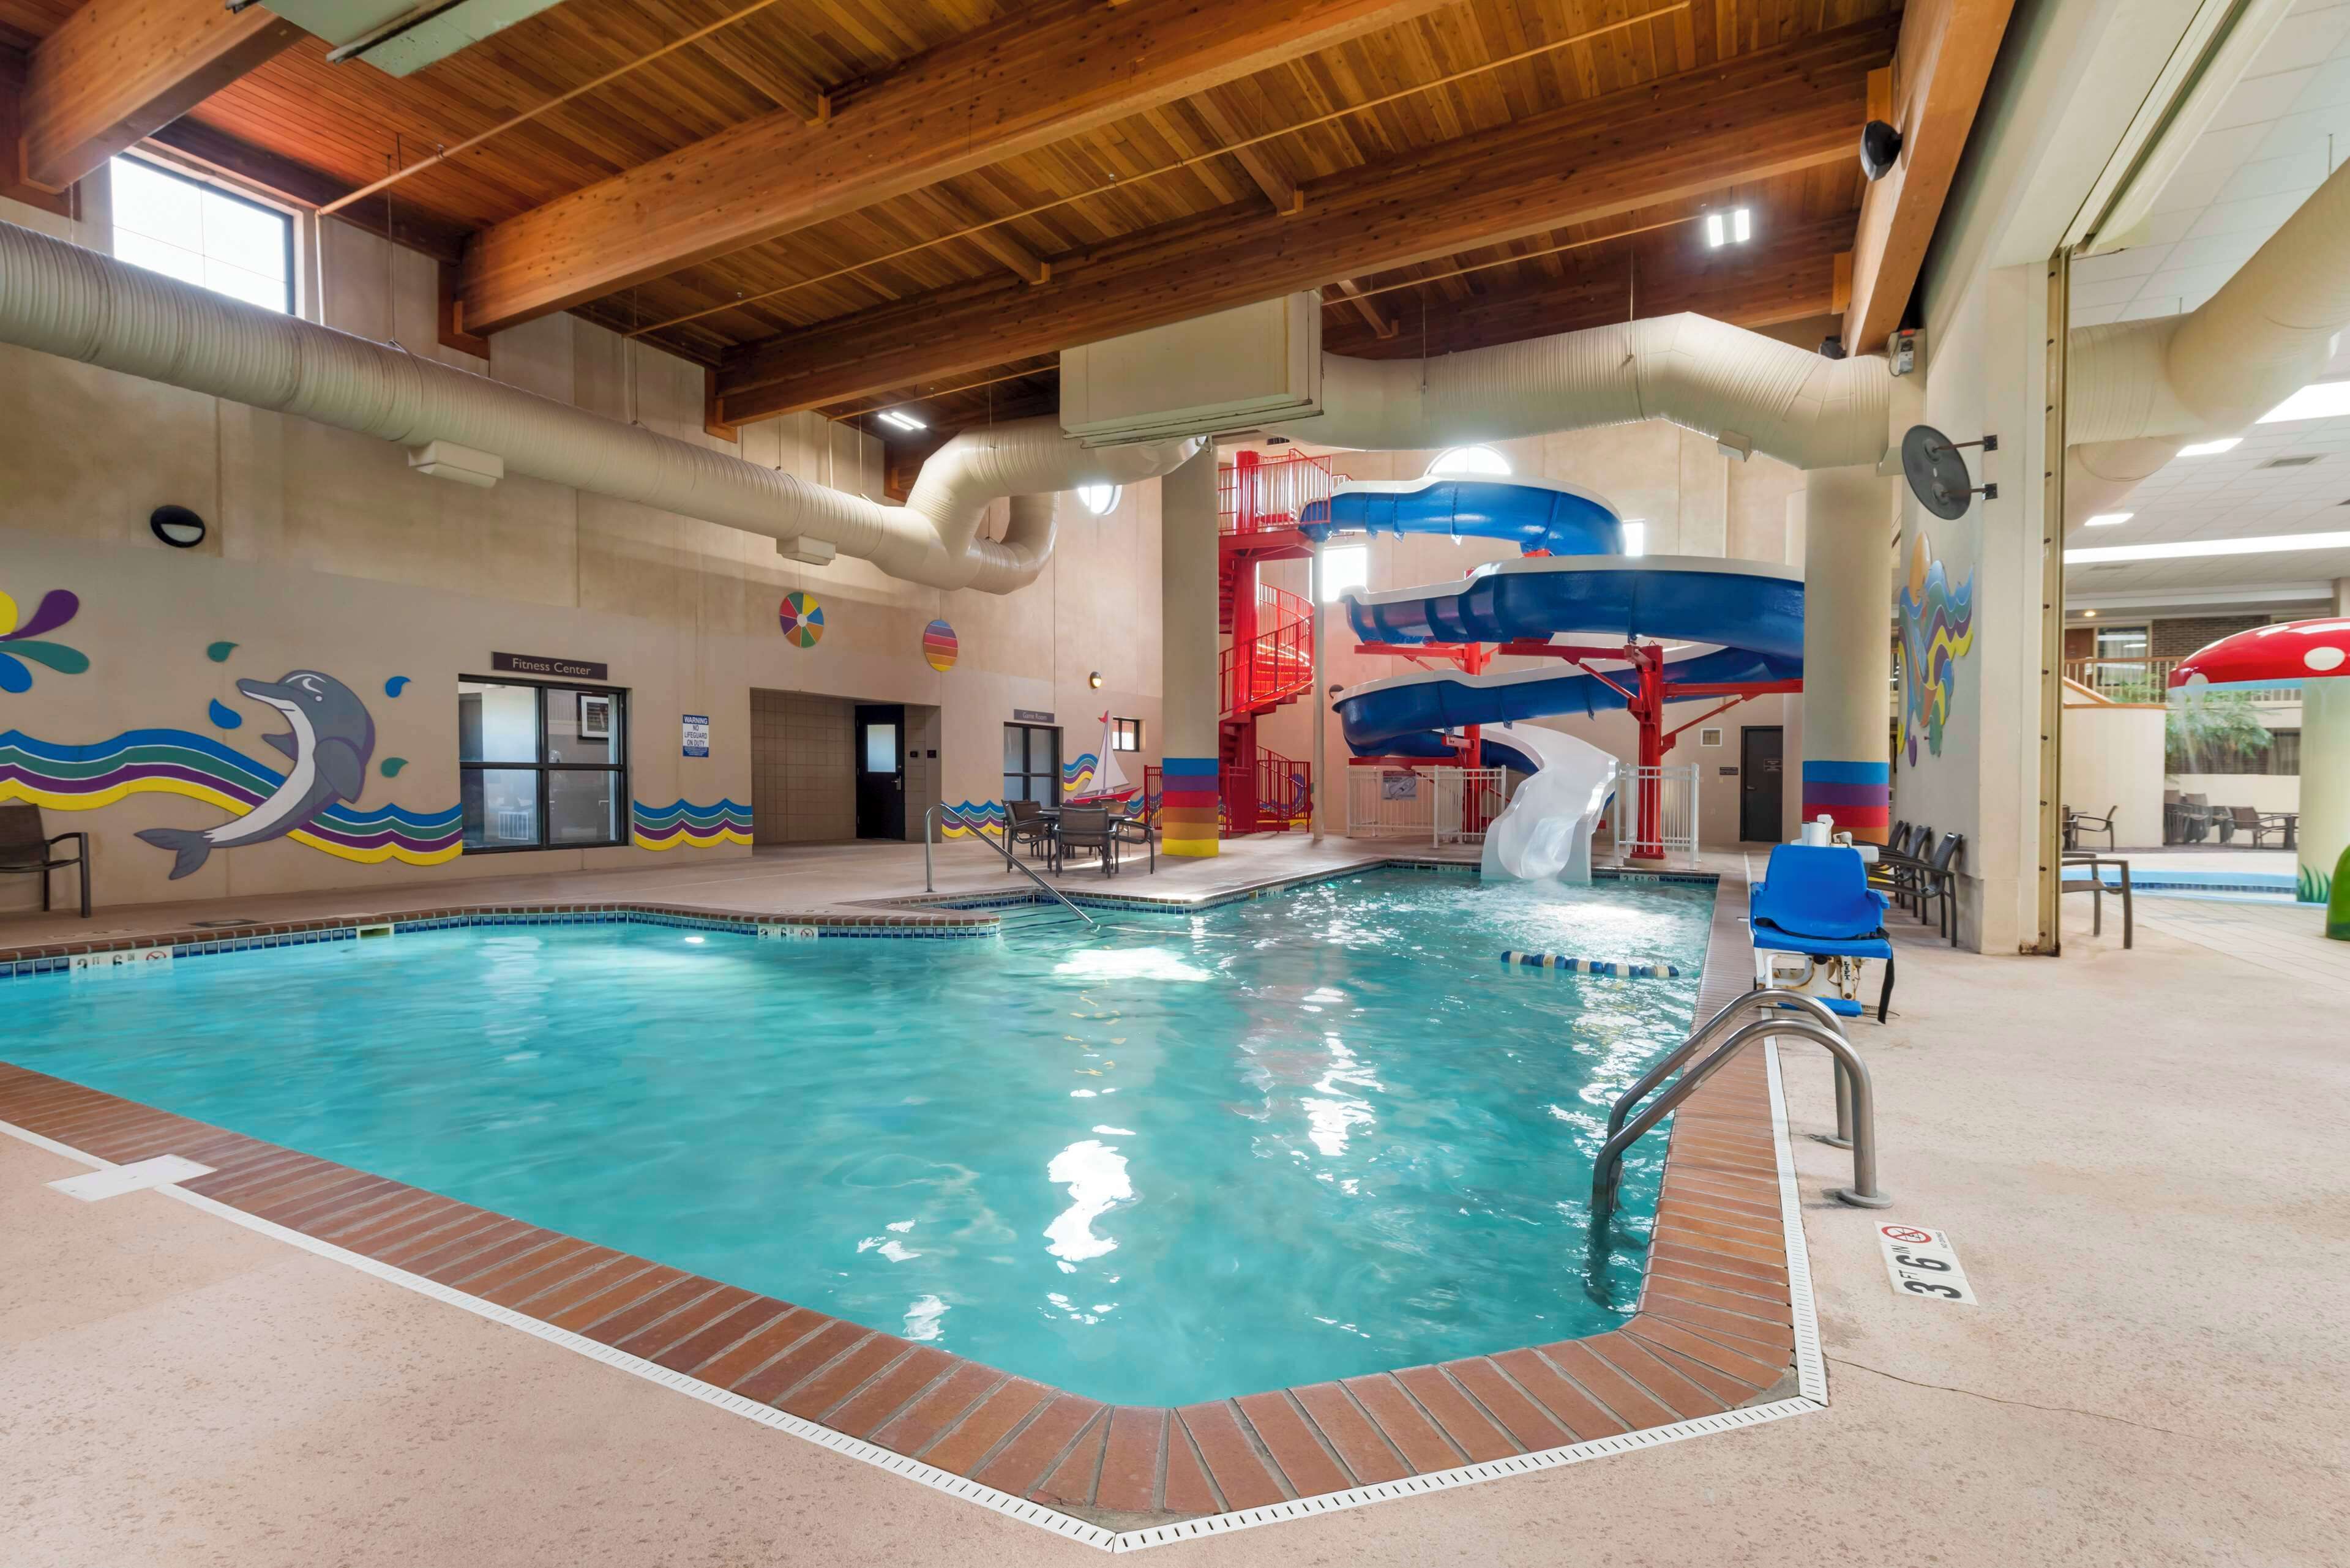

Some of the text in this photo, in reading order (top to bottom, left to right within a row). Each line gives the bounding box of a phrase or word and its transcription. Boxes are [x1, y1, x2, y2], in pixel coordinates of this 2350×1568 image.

[512, 657, 591, 675] Fitness Center
[684, 716, 708, 725] WARNING
[92, 956, 100, 965] FT
[127, 952, 135, 961] IN
[1890, 1244, 1963, 1299] 3 FT 6 IN
